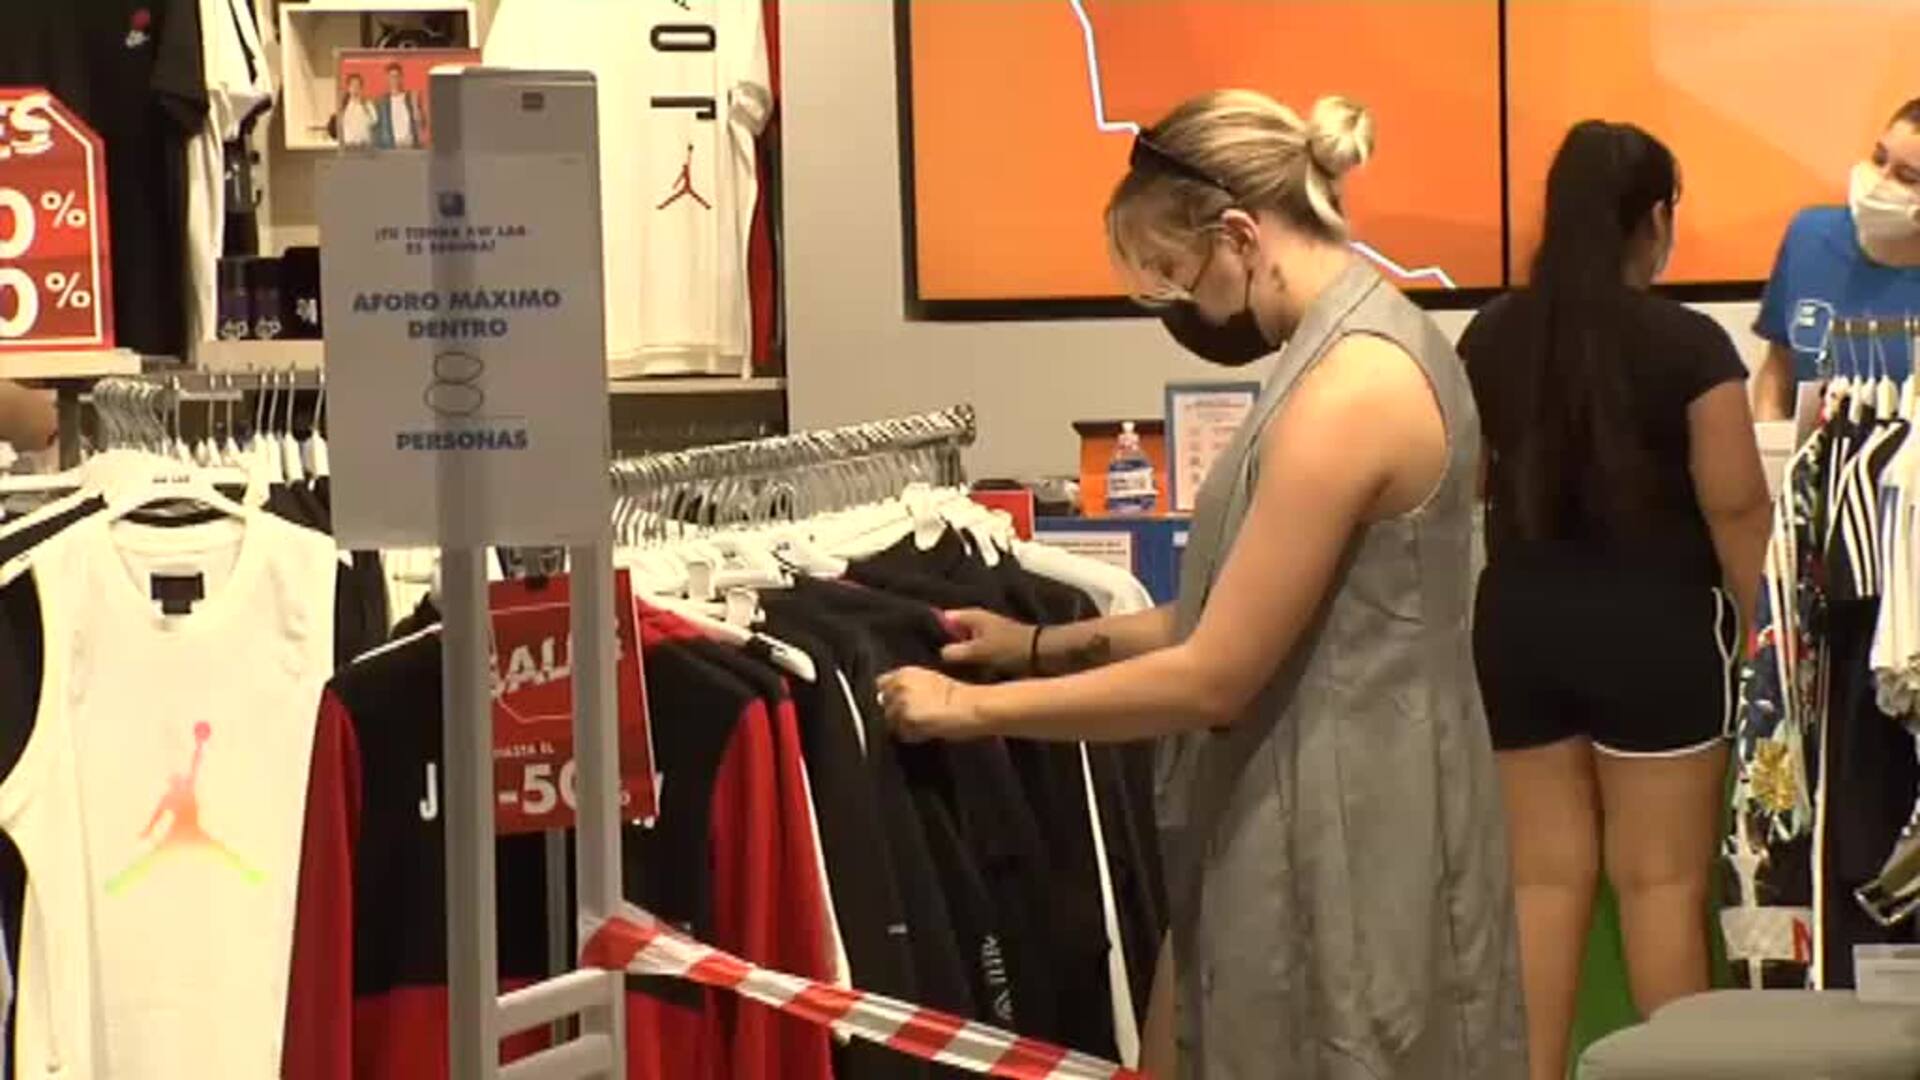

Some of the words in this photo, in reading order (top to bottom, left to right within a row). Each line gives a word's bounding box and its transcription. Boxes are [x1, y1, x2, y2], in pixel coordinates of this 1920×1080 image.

[353, 291, 440, 312] AFORO
[450, 285, 561, 310] MÁXIMO
[408, 318, 508, 339] DENTRO
[424, 351, 484, 417] 8
[396, 430, 528, 451] PERSONAS
